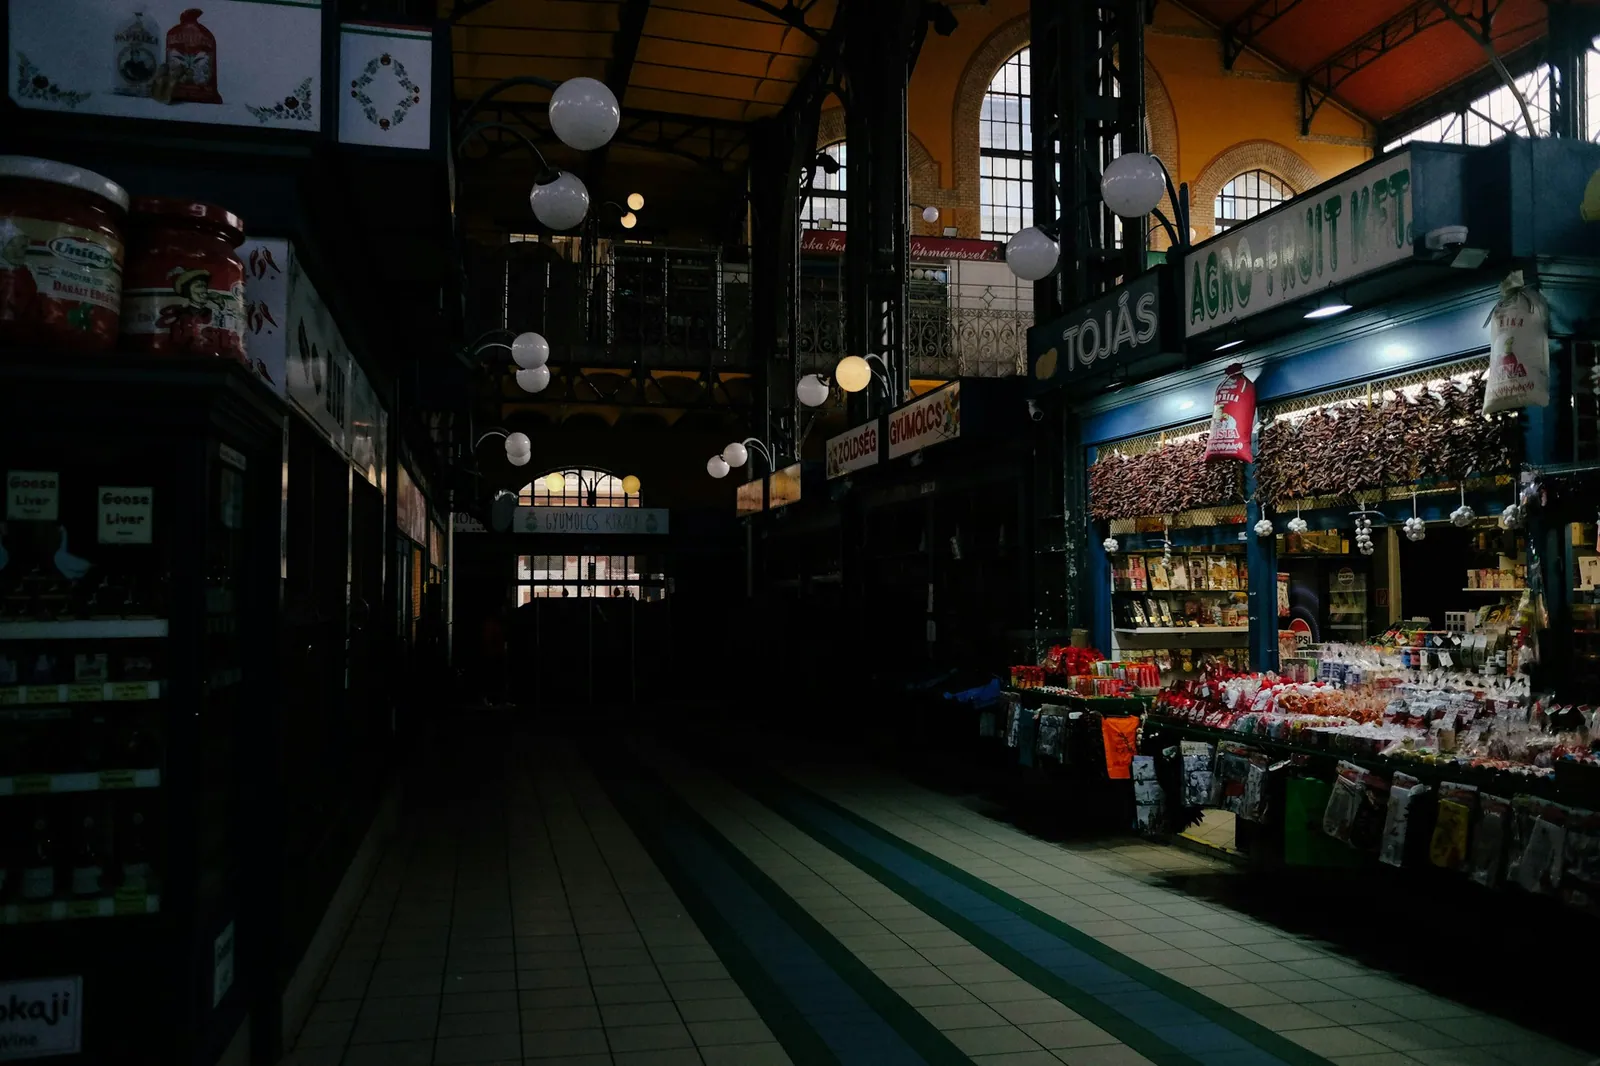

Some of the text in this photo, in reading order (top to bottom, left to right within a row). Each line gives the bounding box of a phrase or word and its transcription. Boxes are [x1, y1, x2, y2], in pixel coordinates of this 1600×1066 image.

[1190, 194, 1342, 325] AGRO-FRUIT
[1062, 289, 1159, 372] TOJÁS
[889, 402, 942, 446] GYÜMÖLCS
[837, 427, 877, 466] ZÖLDSÉG
[10, 476, 56, 489] Goose
[15, 494, 51, 506] Liver
[101, 491, 150, 506] Goose
[105, 512, 146, 526] Liver
[1295, 635, 1311, 645] EPSI
